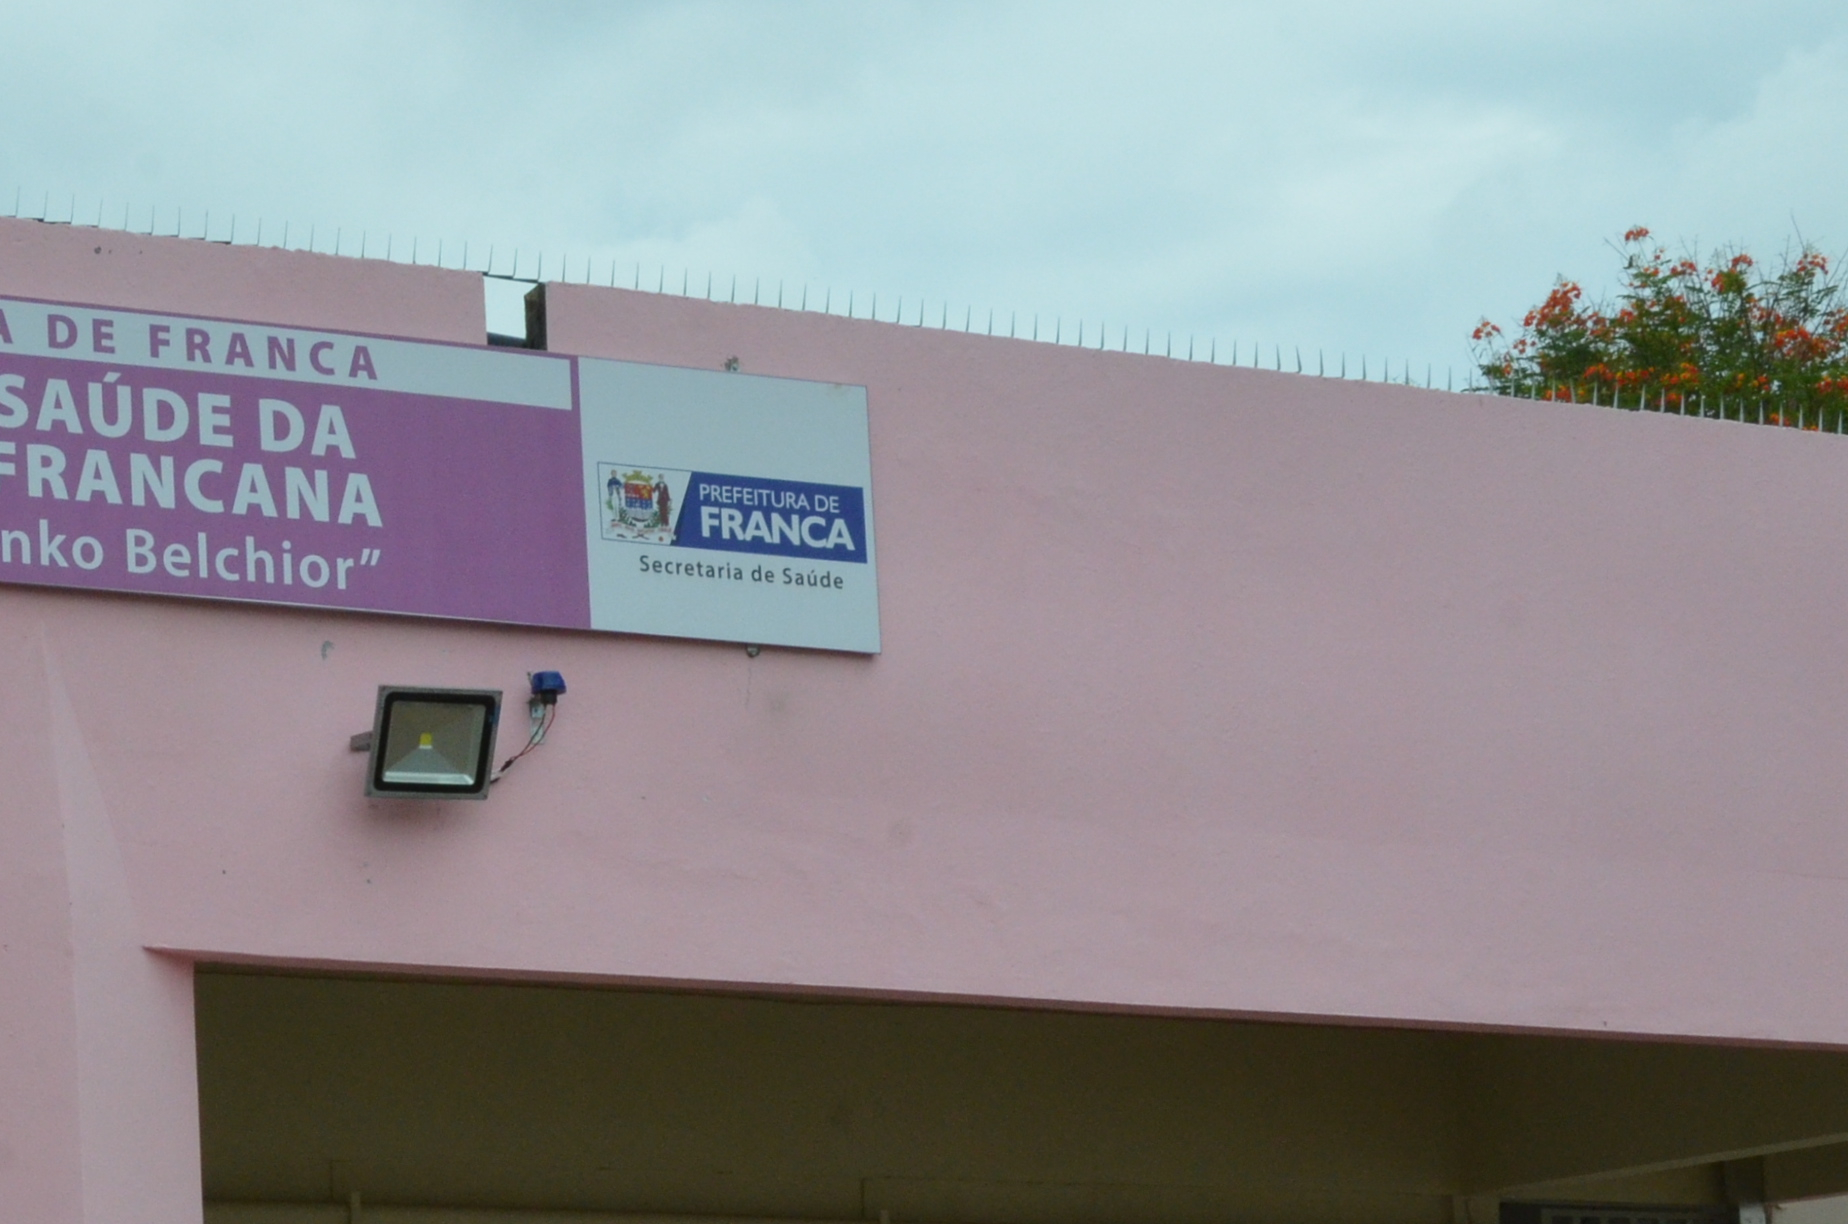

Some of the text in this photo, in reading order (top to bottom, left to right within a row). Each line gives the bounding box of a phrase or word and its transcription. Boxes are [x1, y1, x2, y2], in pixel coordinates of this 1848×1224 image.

[46, 313, 116, 354] DE
[148, 323, 379, 380] FRANCA
[258, 398, 356, 459] DA
[699, 483, 841, 513] PREFEITURA DE
[700, 505, 856, 551] FRANCA
[125, 528, 381, 590] Belchior”
[639, 554, 844, 589] Secretaria de Saúde
